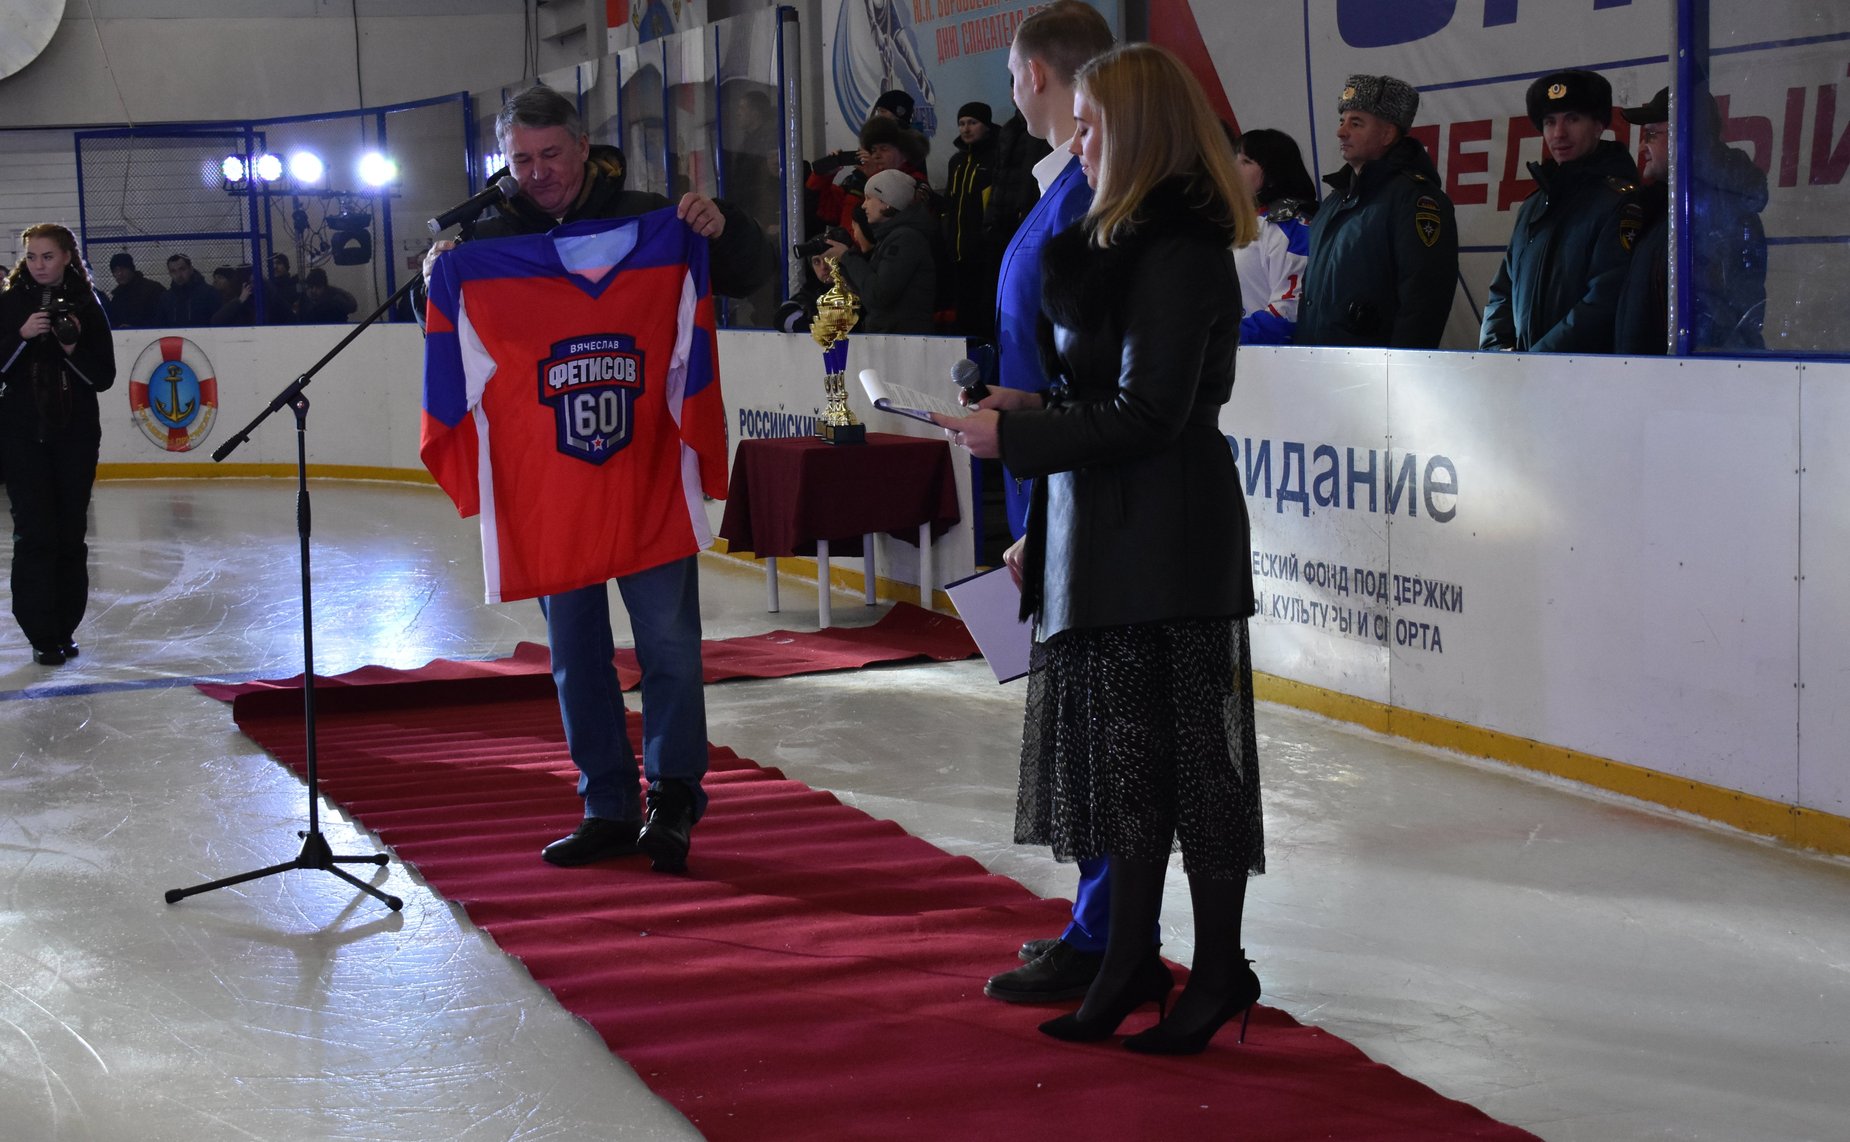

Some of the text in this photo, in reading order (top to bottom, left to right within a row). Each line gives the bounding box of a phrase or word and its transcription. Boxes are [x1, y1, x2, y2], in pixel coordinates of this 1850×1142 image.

[936, 25, 960, 64] ДНЮ
[570, 340, 619, 353] ВЯЧЕСЛАВ
[548, 357, 636, 389] ФЕТИСОВ
[574, 390, 618, 437] 60
[1252, 551, 1299, 582] ЕСКИЙ
[1303, 560, 1349, 597] ФОНД
[1358, 610, 1368, 638] И
